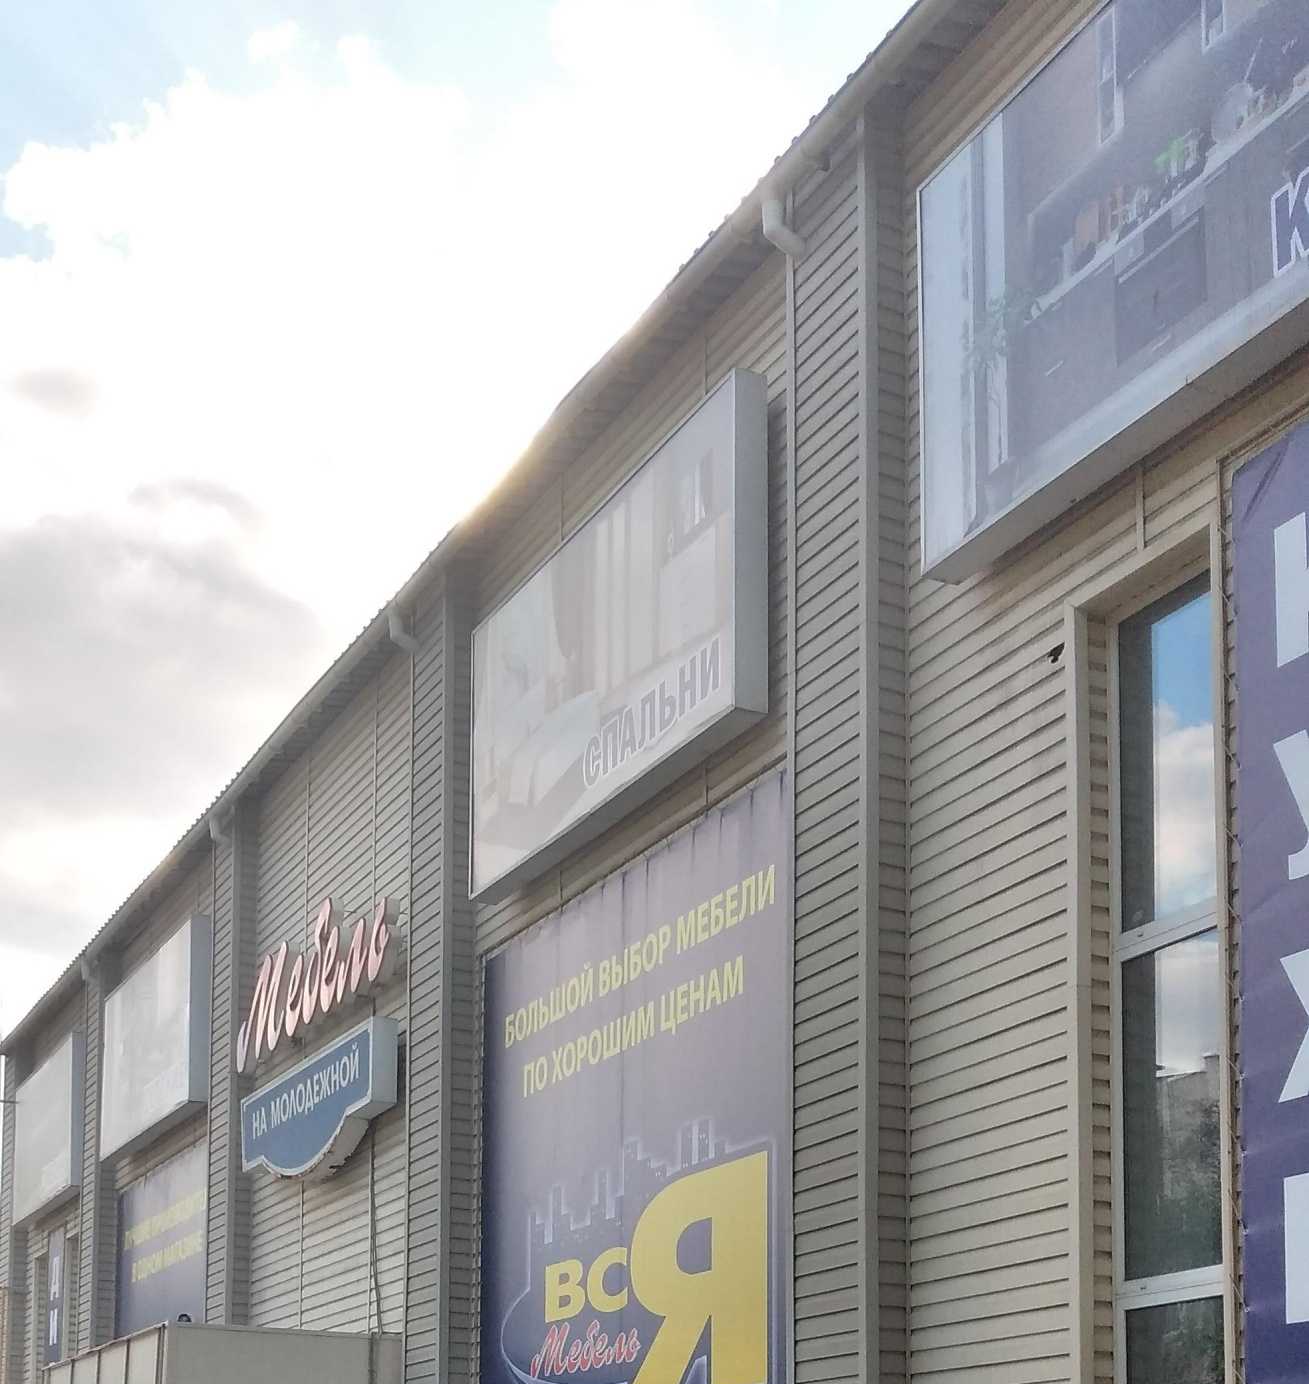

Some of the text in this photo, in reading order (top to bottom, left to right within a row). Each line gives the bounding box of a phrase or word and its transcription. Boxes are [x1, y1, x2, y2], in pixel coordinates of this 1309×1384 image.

[582, 637, 721, 788] СПАЛЬНИ
[237, 897, 391, 1073] Мебель
[505, 864, 776, 1048] БОЛЬШОЙ ВЫБОР МЕБЕЛИ
[523, 955, 744, 1098] ПО ХОРОШИМ ЦЕНАМ
[252, 1042, 360, 1139] НА МОЛОДЕЖНОЙ
[530, 1320, 642, 1379] Мебель
